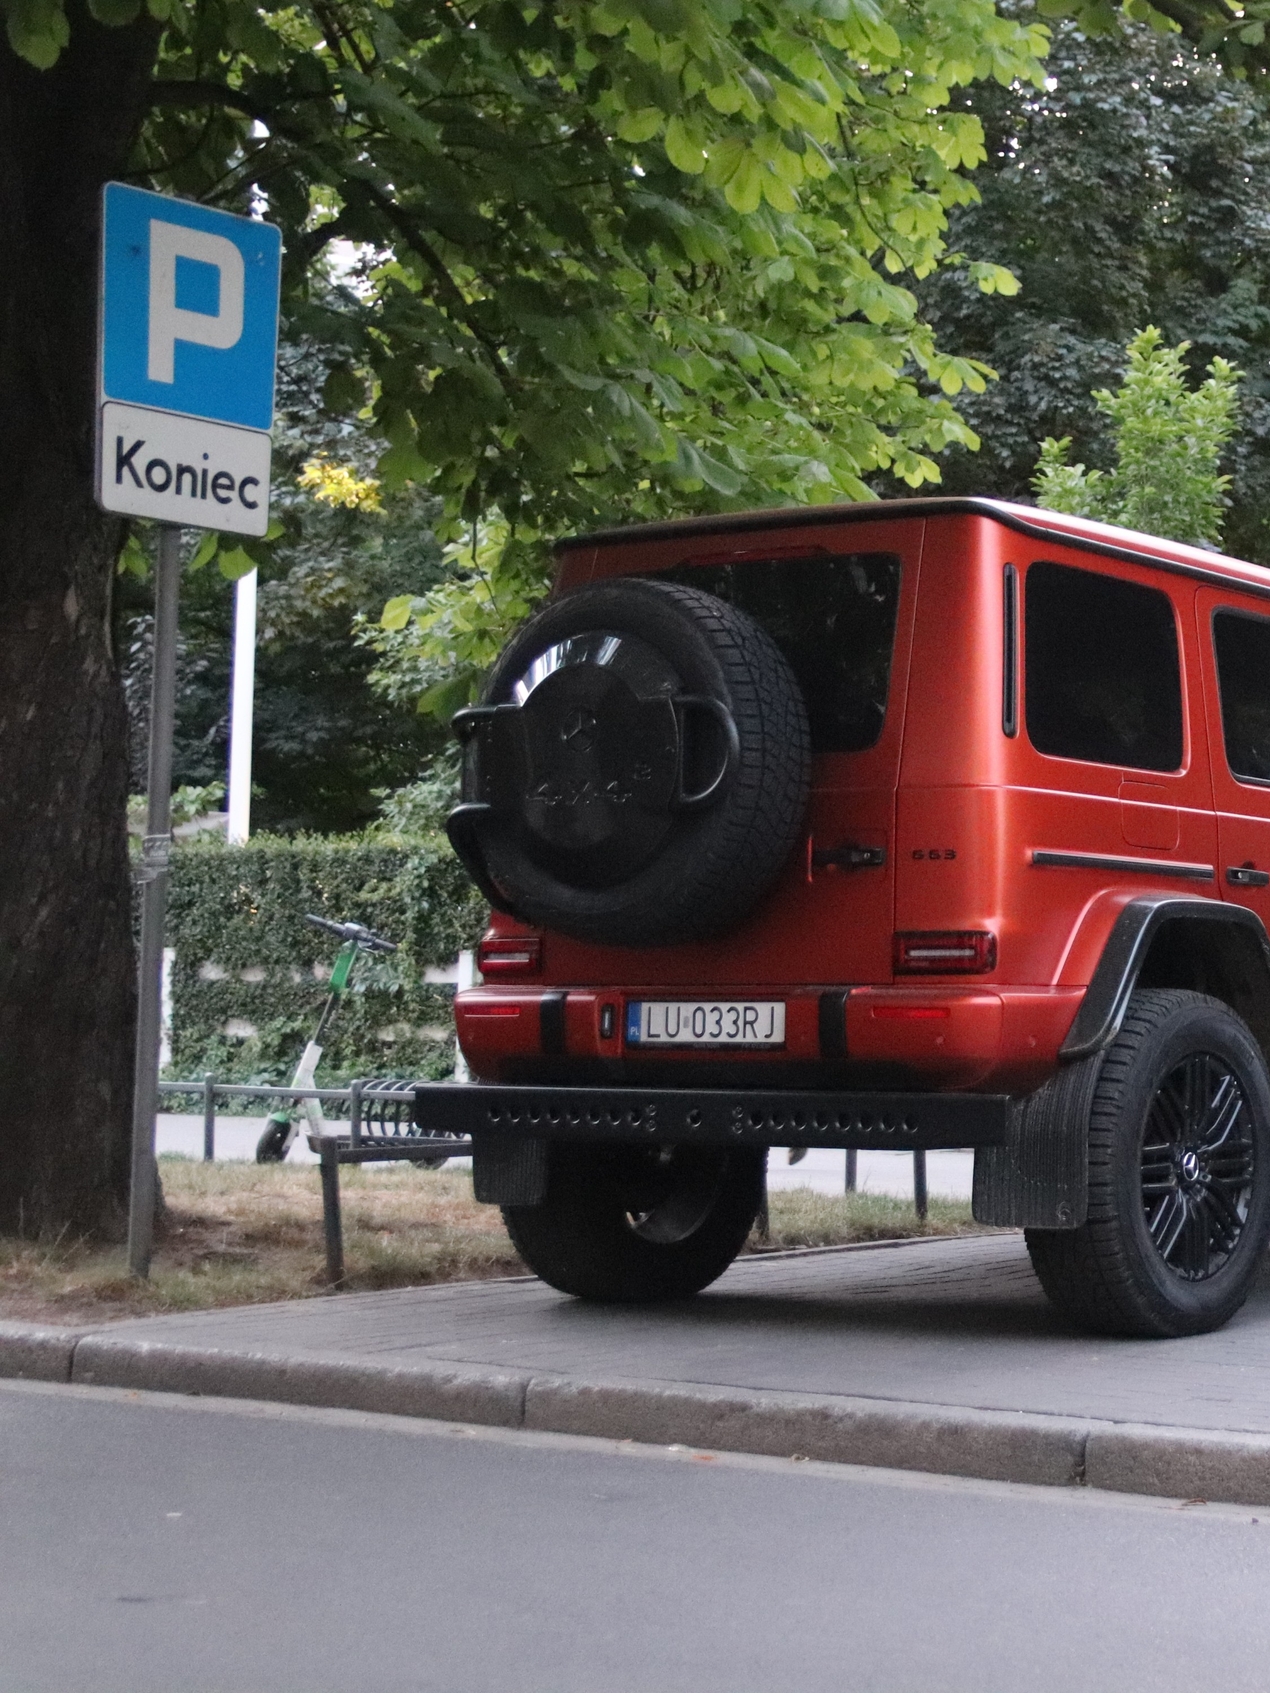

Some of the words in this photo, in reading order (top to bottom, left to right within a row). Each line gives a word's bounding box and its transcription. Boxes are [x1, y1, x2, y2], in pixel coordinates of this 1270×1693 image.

[147, 218, 245, 384] P
[115, 435, 260, 510] Koniec
[630, 1027, 639, 1036] PL
[646, 1006, 680, 1038] LU
[692, 1006, 774, 1039] 033RJ
